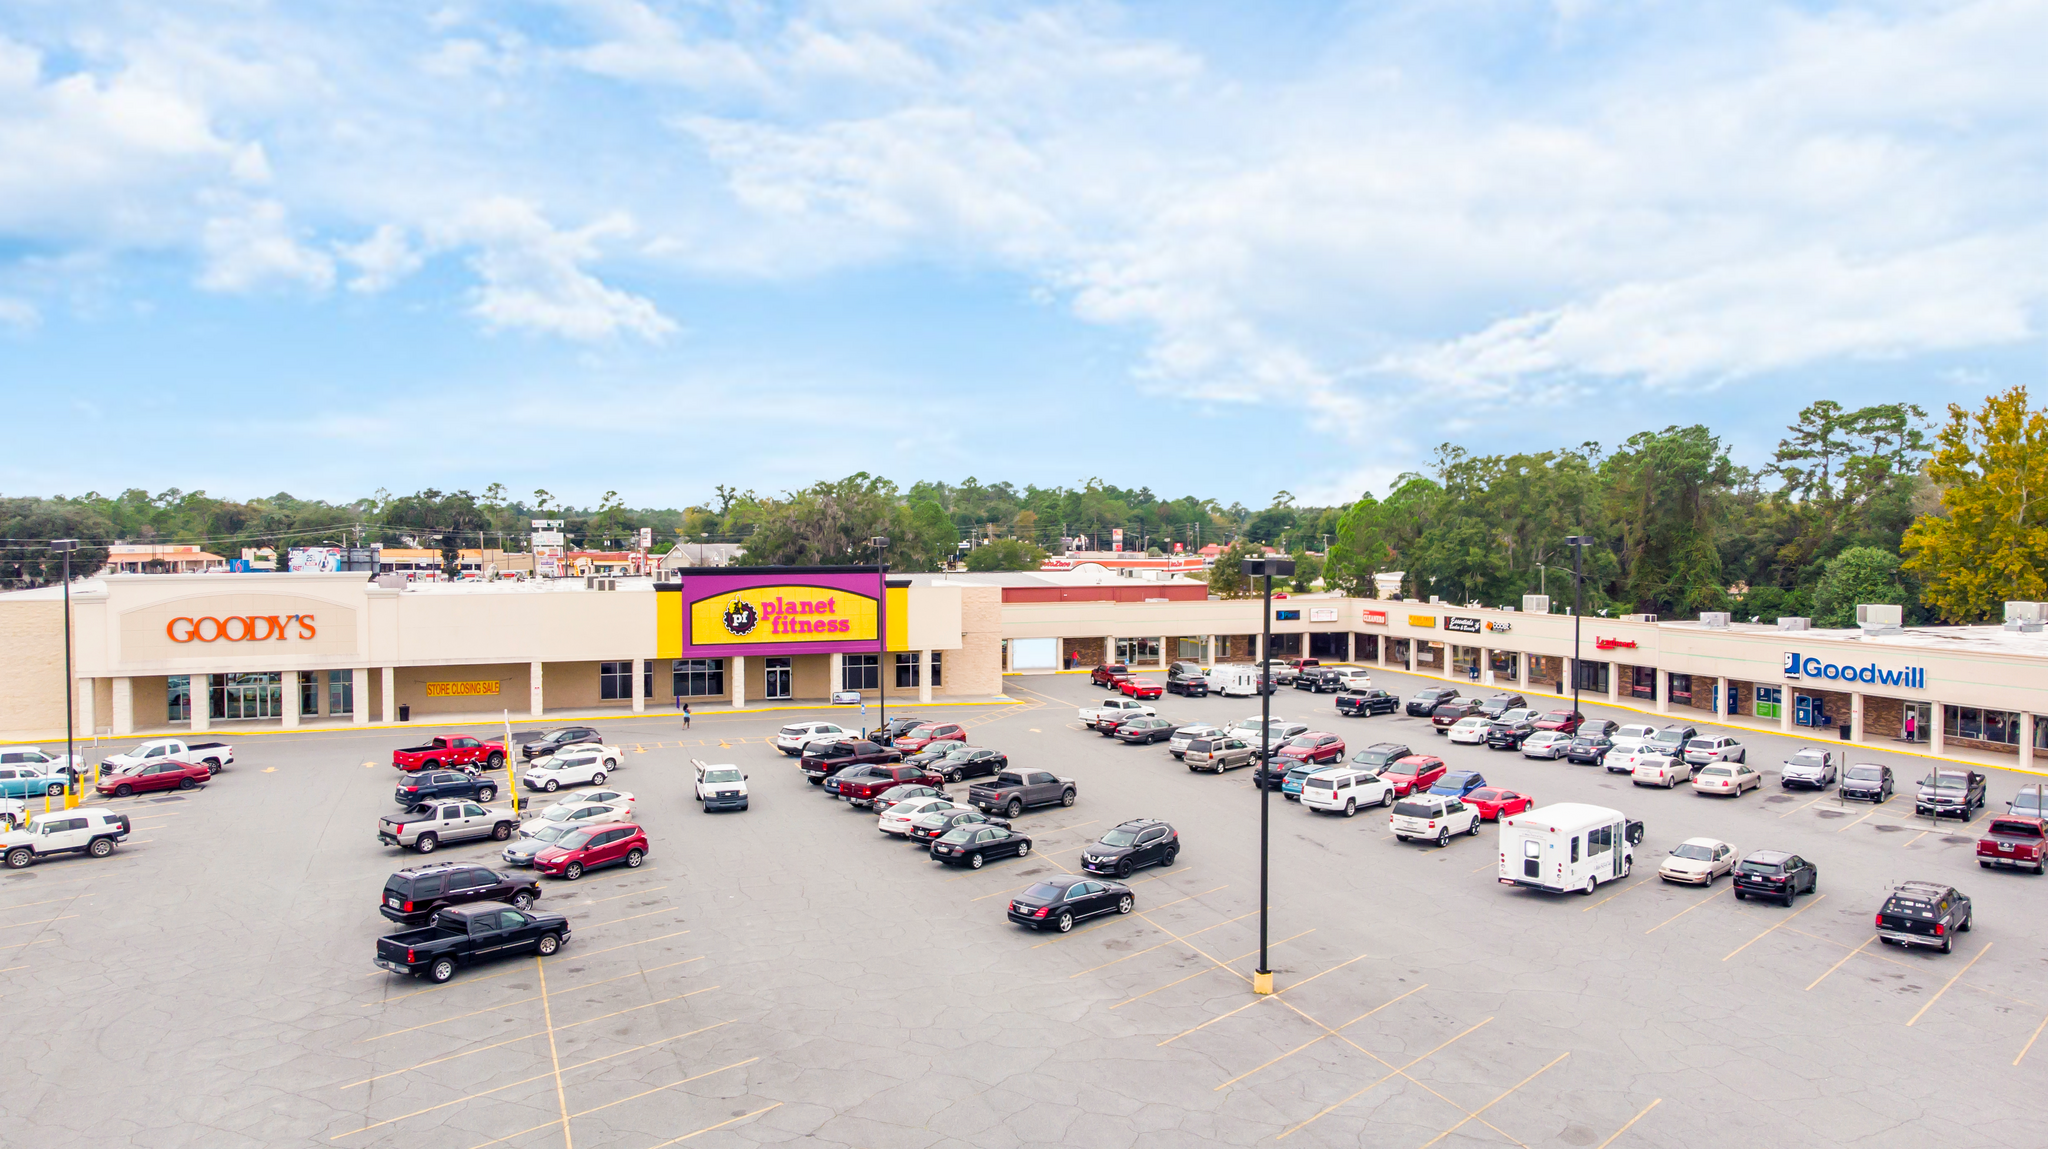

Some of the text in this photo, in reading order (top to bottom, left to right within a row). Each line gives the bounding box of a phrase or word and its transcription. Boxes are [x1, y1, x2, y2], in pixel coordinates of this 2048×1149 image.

[732, 611, 749, 626] pf
[761, 596, 836, 620] planet
[166, 614, 316, 643] GOODY'S
[771, 615, 850, 634] fitness
[1802, 656, 1926, 689] Goodwill
[427, 681, 499, 696] STORE CLOSING SALE
